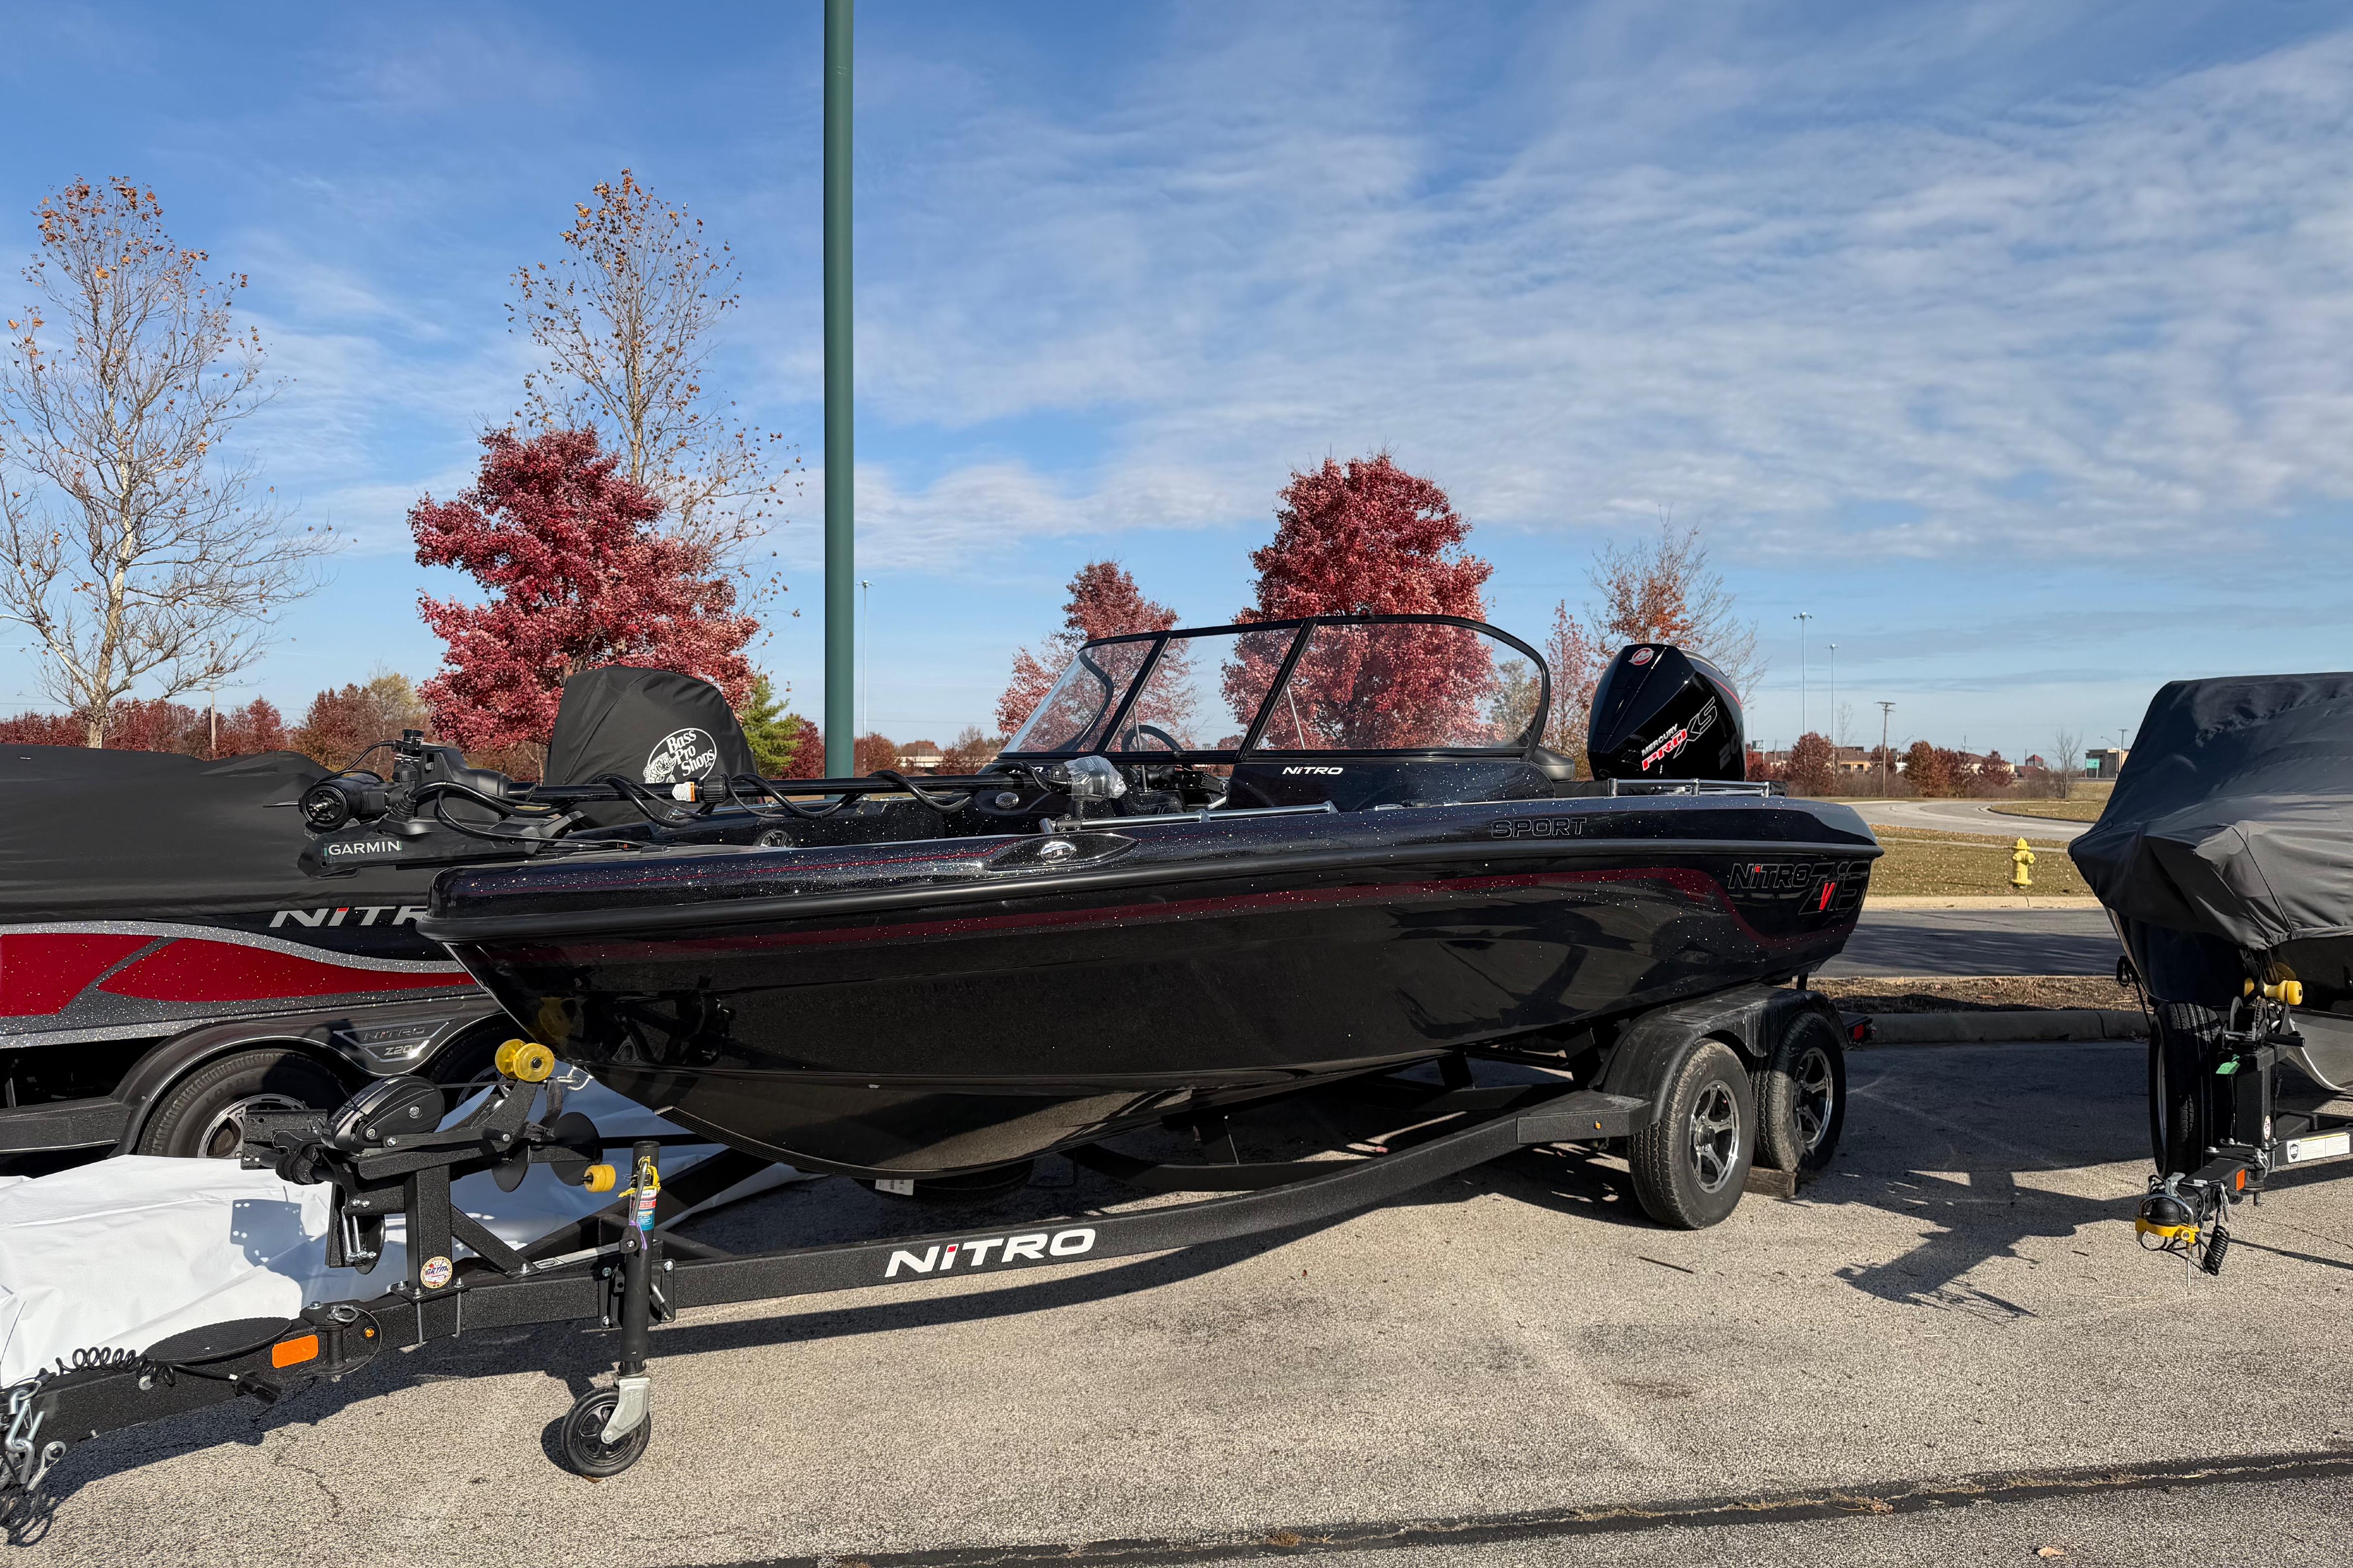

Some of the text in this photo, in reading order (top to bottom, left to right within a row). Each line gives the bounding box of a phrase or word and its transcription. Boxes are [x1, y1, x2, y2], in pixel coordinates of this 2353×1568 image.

[666, 730, 697, 754] Bass
[1641, 723, 1678, 756] MERCURY
[674, 746, 696, 765] Pro
[681, 749, 715, 777] Shops
[1491, 817, 1587, 838] SPORT
[328, 840, 401, 856] GARMIN
[1728, 863, 1812, 889] NITRO
[269, 905, 428, 928] NITR
[364, 1027, 426, 1041] NITRO
[384, 1045, 413, 1056] Z20
[885, 1228, 1096, 1278] NITRO
